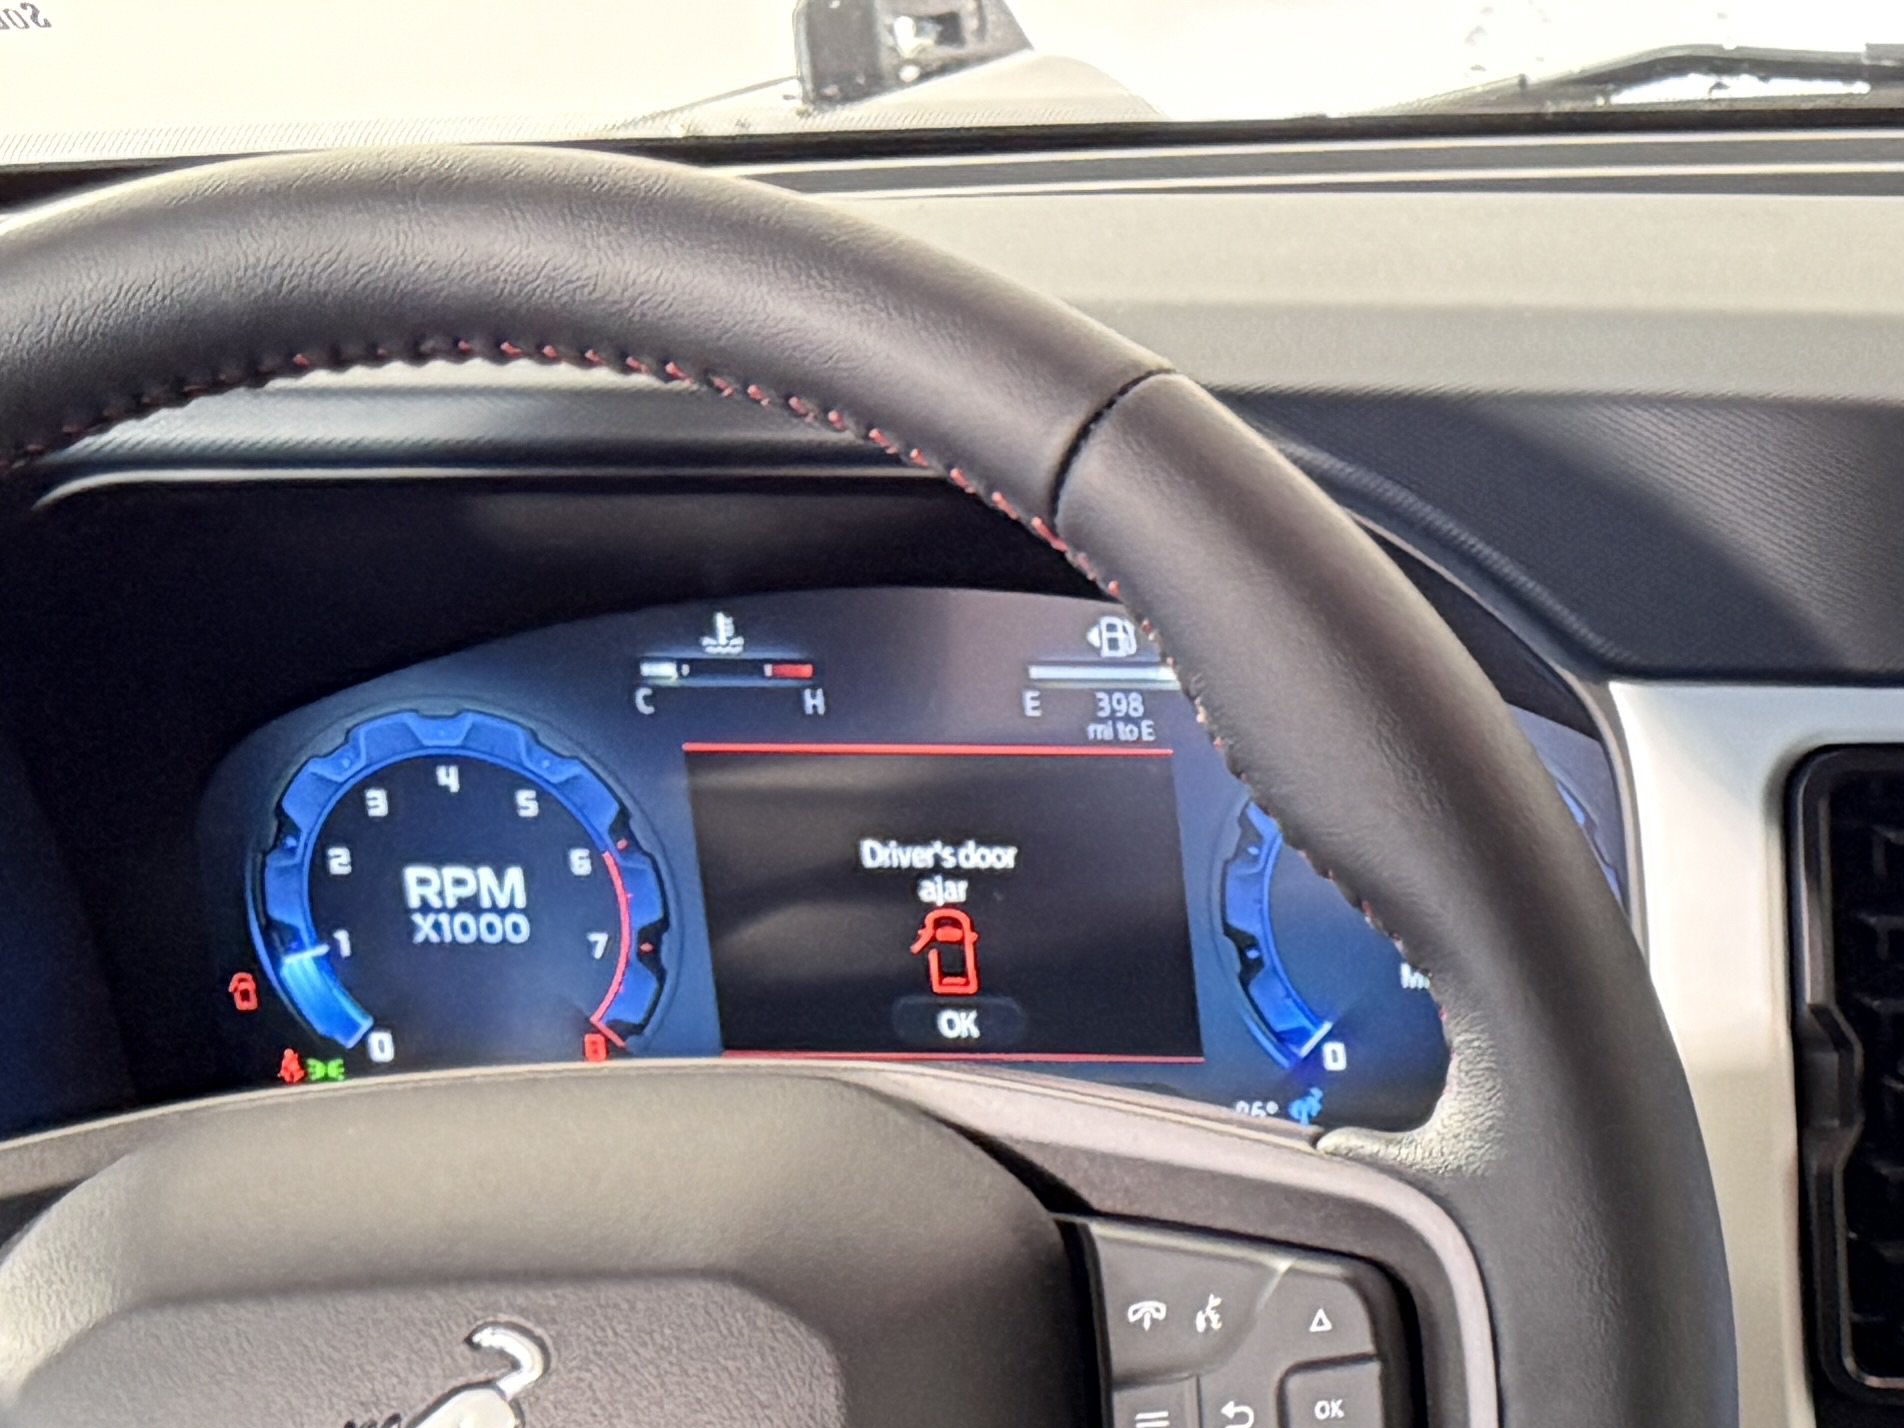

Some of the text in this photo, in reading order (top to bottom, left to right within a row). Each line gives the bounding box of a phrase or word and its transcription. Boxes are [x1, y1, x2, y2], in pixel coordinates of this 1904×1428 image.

[635, 686, 826, 715] C H
[1023, 690, 1145, 718] E 398
[1087, 719, 1156, 742] mi to E
[435, 765, 460, 793] 4
[365, 788, 389, 817] 3
[515, 789, 540, 818] 5
[327, 846, 352, 875] 2
[569, 848, 592, 876] 6
[860, 839, 1018, 869] Driver's door
[402, 864, 527, 909] RPM
[916, 874, 969, 907] ajar
[333, 929, 351, 959] 1
[587, 932, 609, 960] 7
[936, 1009, 981, 1039] OK
[368, 1031, 393, 1062] 0
[1322, 1041, 1348, 1072] 0
[1314, 1398, 1345, 1420] OK
